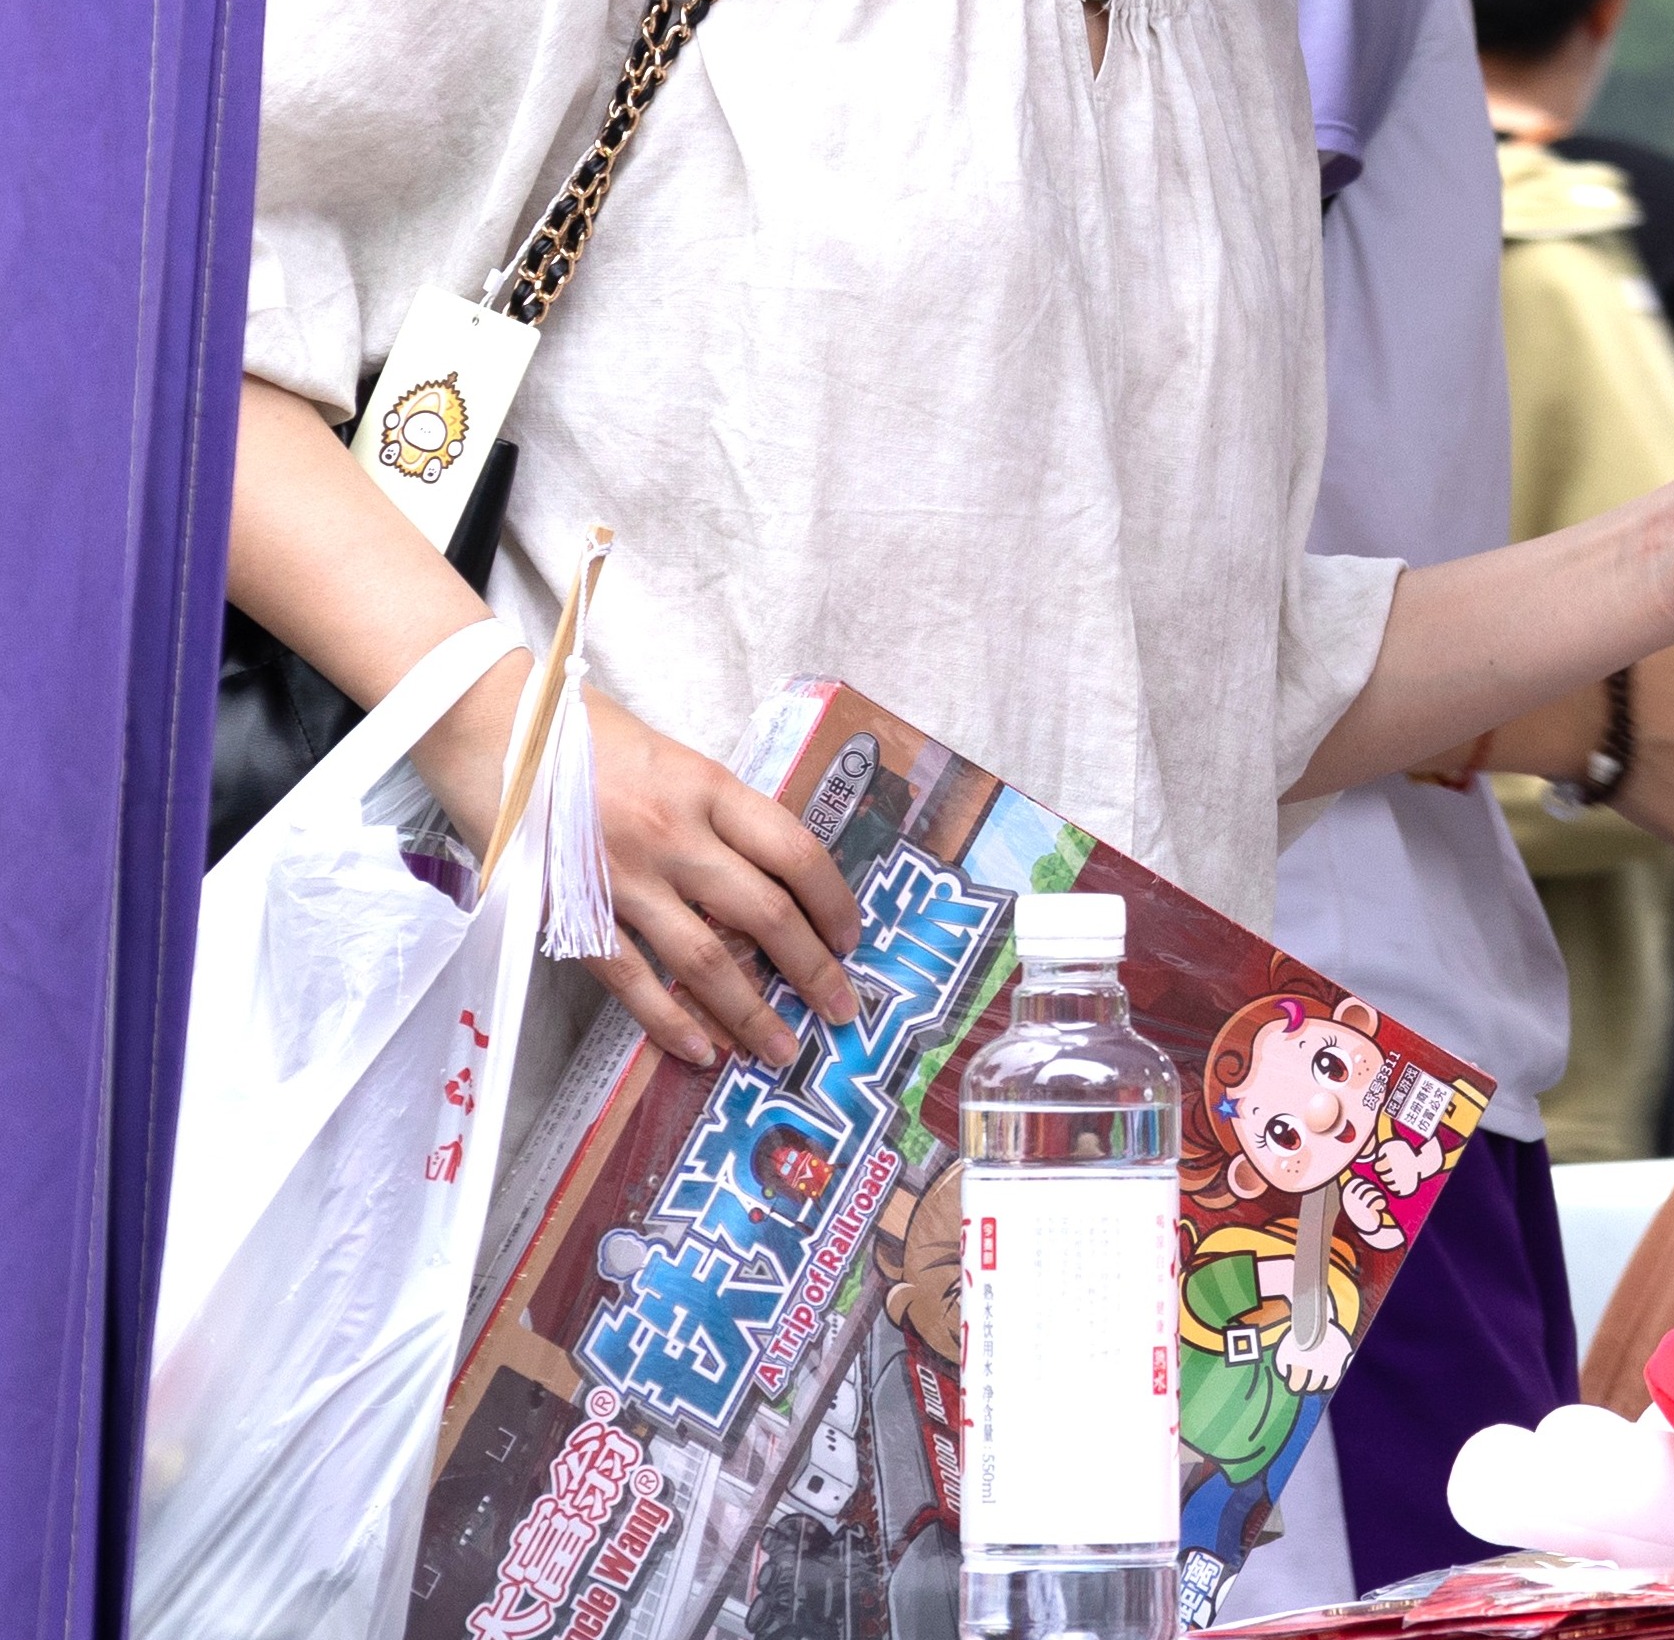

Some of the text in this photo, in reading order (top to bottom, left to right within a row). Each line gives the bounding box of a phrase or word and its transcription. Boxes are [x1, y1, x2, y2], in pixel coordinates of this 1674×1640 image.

[1363, 1050, 1401, 1111] 货号3311
[1404, 1080, 1434, 1125] 注册商标
[1418, 1088, 1447, 1132] 仿冒必究
[755, 1149, 898, 1388] A Trip of Railroads
[470, 1421, 642, 1640] 大富翁
[553, 1498, 670, 1640] ncle Wang
